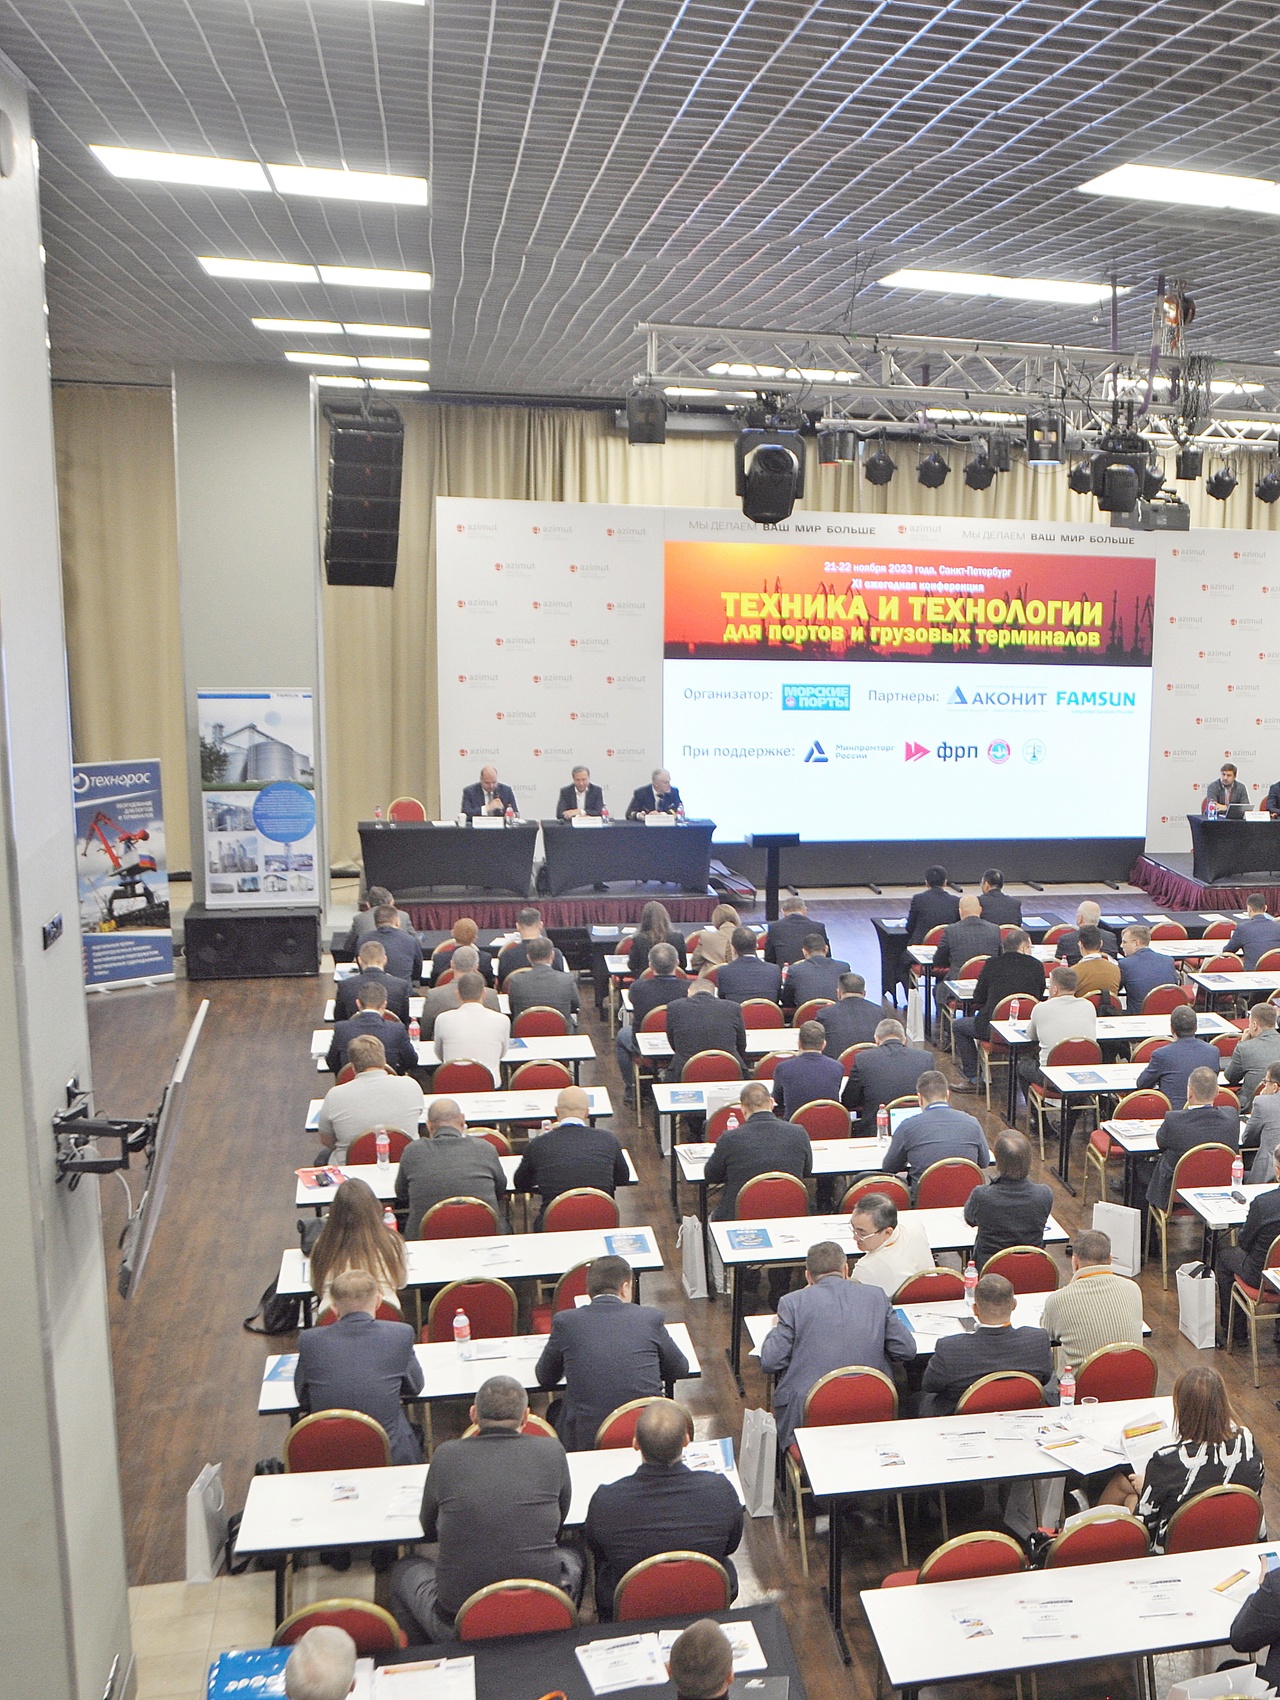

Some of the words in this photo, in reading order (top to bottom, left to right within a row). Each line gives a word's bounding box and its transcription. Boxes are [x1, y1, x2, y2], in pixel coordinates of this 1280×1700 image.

[467, 523, 497, 531] azimut
[689, 521, 709, 531] МЫ
[710, 521, 757, 532] ДЕЛАЕМ
[763, 523, 790, 533] ВАШ
[795, 525, 822, 533] МИР
[827, 526, 876, 535] БОЛЬШЕ
[909, 524, 942, 533] azimut
[962, 530, 981, 539] МЫ
[982, 531, 1026, 541] ДЕЛАЕМ
[1031, 533, 1056, 541] ВАШ
[1060, 534, 1085, 543] МИР
[1090, 535, 1135, 545] БОЛЬШЕ
[1180, 548, 1206, 556] azimut
[823, 562, 851, 573] 21-22
[853, 563, 887, 575] ноября
[888, 563, 913, 574] 2023
[938, 565, 1012, 578] Санкт-Петербург
[864, 580, 917, 591] ежегодная
[919, 582, 985, 593] конференция
[468, 599, 498, 607] azimut
[543, 600, 572, 608] azimut
[617, 601, 645, 609] azimut
[720, 592, 870, 621] ТЕХНИКА
[878, 595, 900, 622] И
[908, 596, 1103, 627] ТЕХНОЛОГИИ
[723, 624, 763, 643] для
[768, 625, 845, 645] портов
[851, 626, 865, 642] и
[870, 626, 971, 646] грузовых
[975, 628, 1101, 649] терминалов
[683, 688, 773, 702] Организатор:
[784, 686, 849, 697] МОРСКИЕ
[868, 690, 940, 703] Партнеры:
[798, 697, 849, 708] ПОРТЫ
[971, 692, 1048, 706] АКОНИТ
[1055, 691, 1136, 707] FAMSUN
[682, 745, 709, 758] При
[713, 746, 795, 758] поддержке:
[835, 744, 895, 752] Минпромторг
[936, 741, 978, 762] фрп
[835, 752, 867, 760] России
